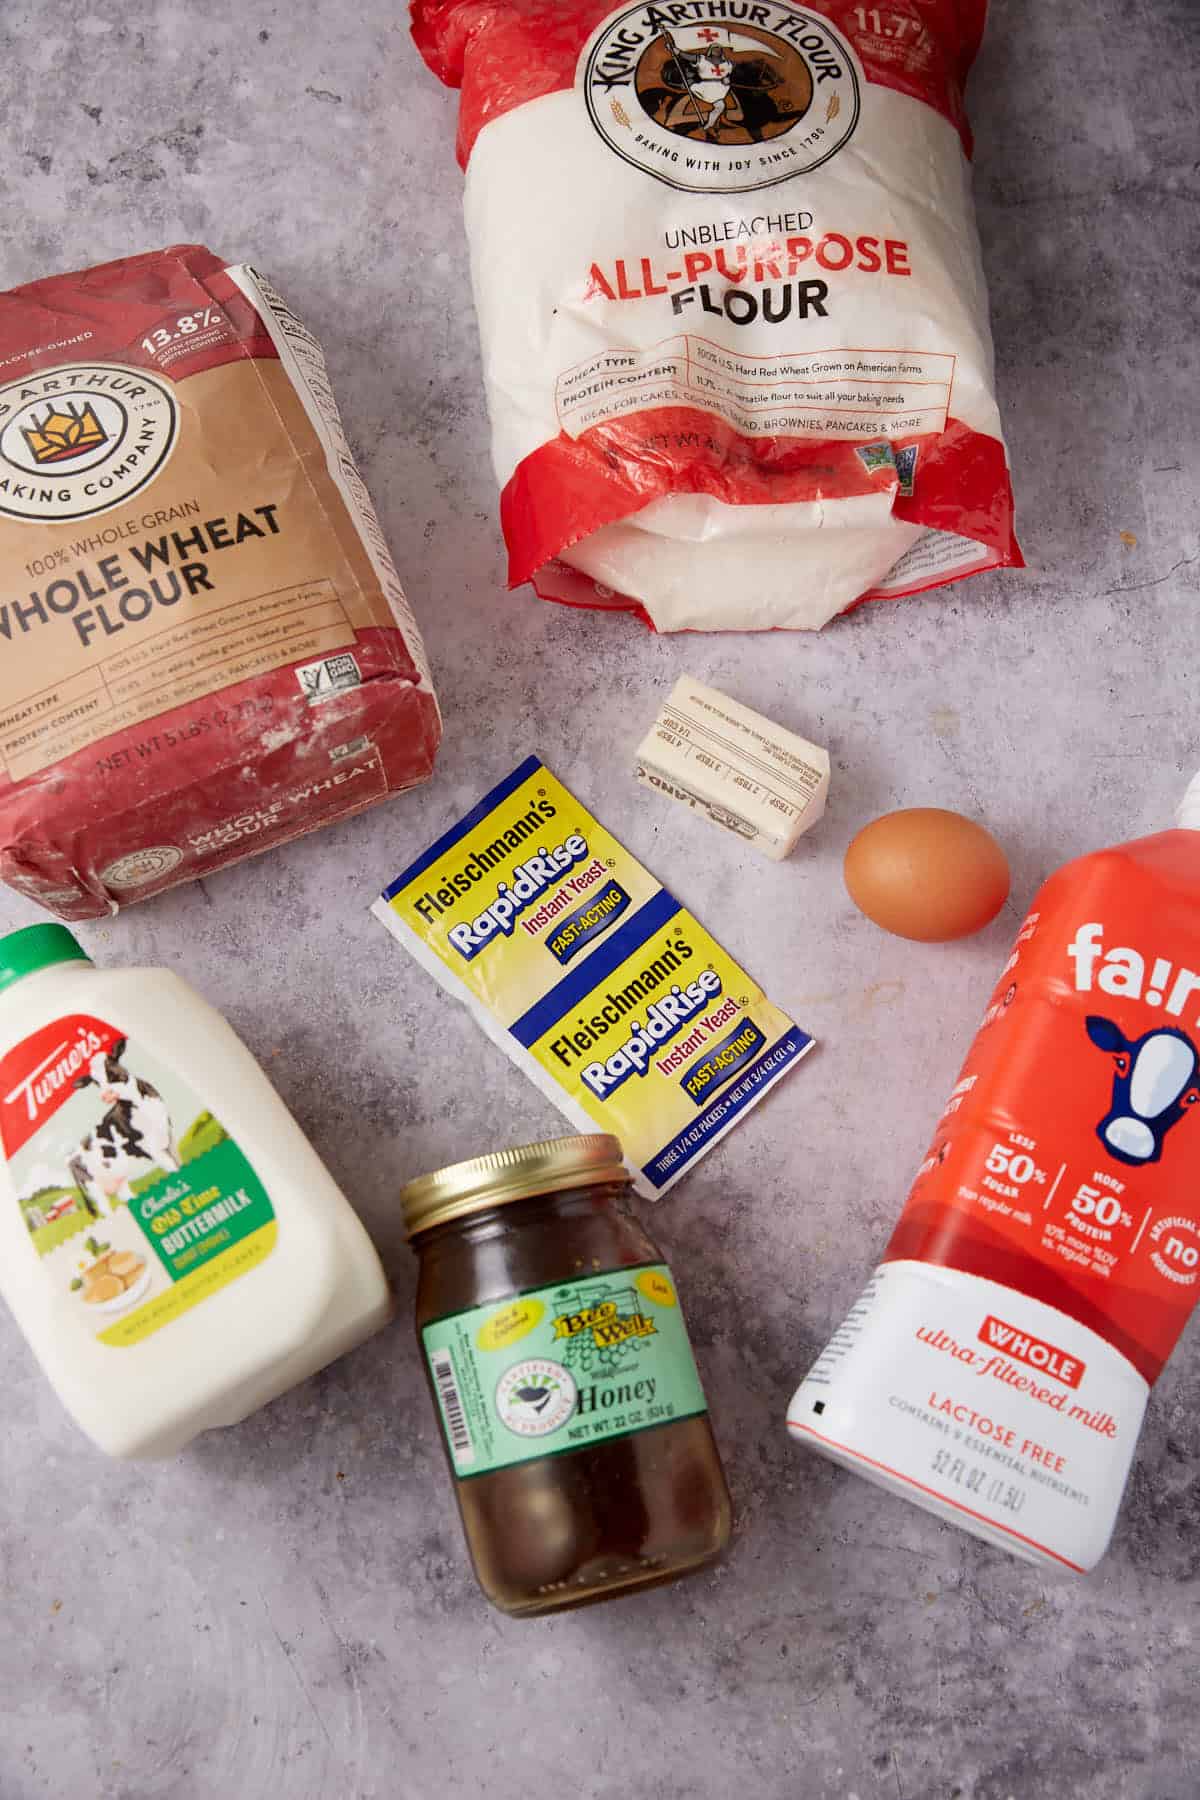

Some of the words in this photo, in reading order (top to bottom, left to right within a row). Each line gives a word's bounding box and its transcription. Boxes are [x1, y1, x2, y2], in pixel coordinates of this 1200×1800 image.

[592, 29, 644, 94] KING
[642, 1, 770, 36] ARTHUR
[771, 9, 842, 84] FLOUR
[635, 133, 679, 163] BAKING
[686, 157, 721, 171] WITH
[728, 160, 752, 171] JOY
[759, 147, 798, 166] SINCE
[799, 127, 826, 150] 1790
[664, 212, 814, 249] UNBLEACHED
[584, 232, 912, 301] ALL-PURPOSE
[671, 279, 829, 326] FLOUR
[47, 331, 94, 351] OWNED
[142, 308, 221, 355] 13.8%
[20, 374, 146, 400] ARTHUR
[563, 379, 614, 407] PROTEIN
[617, 365, 677, 384] CONTENT
[564, 361, 600, 386] WHEAT
[605, 358, 637, 367] TYPE
[735, 364, 757, 377] Hard
[759, 367, 778, 377] Red
[780, 366, 810, 376] Wheat
[811, 362, 842, 373] Grown
[844, 363, 855, 371] on
[857, 361, 897, 373] American
[899, 362, 922, 374] Farms
[771, 393, 791, 401] flour
[806, 392, 823, 400] suit
[825, 392, 835, 400] all
[837, 393, 856, 403] your
[858, 392, 881, 406] baking
[882, 393, 905, 404] needs
[764, 418, 823, 431] BROWNIES,
[825, 419, 878, 433] PANCAKES
[881, 424, 888, 432] &
[84, 417, 157, 497] COMPANY
[25, 548, 71, 579] 100%
[70, 519, 140, 557] WHOLE
[141, 500, 201, 530] GRAIN
[129, 503, 281, 574] WHEAT
[72, 562, 215, 647] FLOUR
[5, 724, 49, 751] PROTEIN
[51, 699, 97, 729] CONTENT
[34, 693, 58, 711] TYPE
[96, 749, 132, 771] NET
[135, 736, 161, 758] WT
[187, 800, 285, 847] WHOLE
[288, 757, 378, 804] WHEAT
[733, 775, 754, 791] TBSP
[769, 797, 789, 813] TBSP
[195, 814, 280, 855] FLOUR
[413, 797, 557, 925] Fleischmann's
[449, 834, 588, 957] RapidRise
[521, 888, 574, 936] Instant
[566, 860, 608, 897] Yeast
[551, 887, 623, 957] FAST-ACTING
[549, 938, 694, 1068] Fleischmann's
[581, 968, 722, 1094] RapidRise
[656, 1027, 709, 1077] Instant
[700, 996, 742, 1034] Yeast
[4, 1026, 102, 1121] Turner's
[686, 1027, 758, 1098] FAST-ACTING
[656, 1147, 681, 1174] THREE
[676, 1138, 692, 1153] 1/4
[689, 1127, 703, 1143] OZ
[699, 1103, 728, 1131] PACKETS
[729, 1088, 745, 1105] NET
[740, 1078, 755, 1095] WT
[751, 1066, 767, 1083] 3/4
[764, 1056, 777, 1072] OZ
[985, 1143, 1048, 1184] 50%
[1008, 1133, 1037, 1151] LESS
[982, 1175, 1020, 1199] SUGAR
[1072, 1183, 1134, 1227] 50%
[1092, 1171, 1126, 1194] MORE
[160, 1188, 253, 1255] BUTTERMILK
[1064, 1210, 1112, 1242] PROTEIN
[1164, 1237, 1199, 1268] no
[561, 1303, 612, 1334] Bee
[593, 1313, 647, 1343] Well
[987, 1319, 1076, 1383] WHOLE
[576, 1377, 657, 1416] Honey
[914, 1325, 1071, 1414] ultra-filtered
[1066, 1403, 1119, 1440] milk
[568, 1424, 590, 1440] NET
[613, 1414, 627, 1429] 22
[888, 1394, 951, 1435] CONTAINS
[964, 1434, 1027, 1476] ESSENTIAL
[1029, 1466, 1091, 1506] NUTRIENTS
[928, 1391, 1017, 1449] LACTOSE
[1020, 1439, 1067, 1474] FREE
[931, 1447, 951, 1475] 52
[948, 1457, 966, 1485] FL
[966, 1466, 987, 1494] OZ
